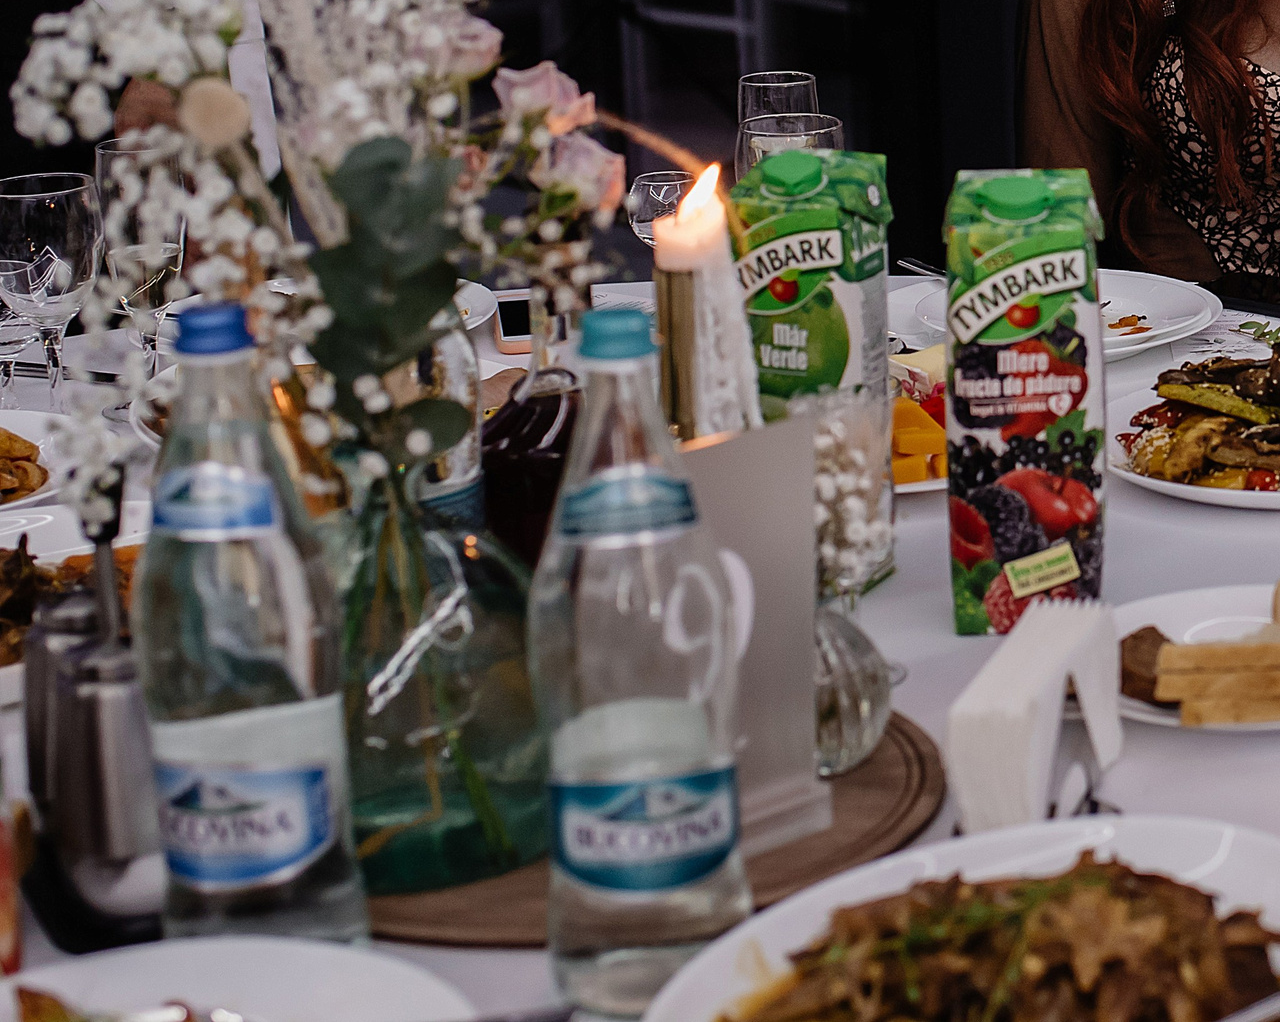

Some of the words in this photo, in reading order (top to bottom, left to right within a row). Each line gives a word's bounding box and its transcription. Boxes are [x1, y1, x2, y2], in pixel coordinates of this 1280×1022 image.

[738, 237, 834, 290] YMBARK
[954, 258, 1079, 330] TYMBARK
[760, 344, 808, 370] Verde
